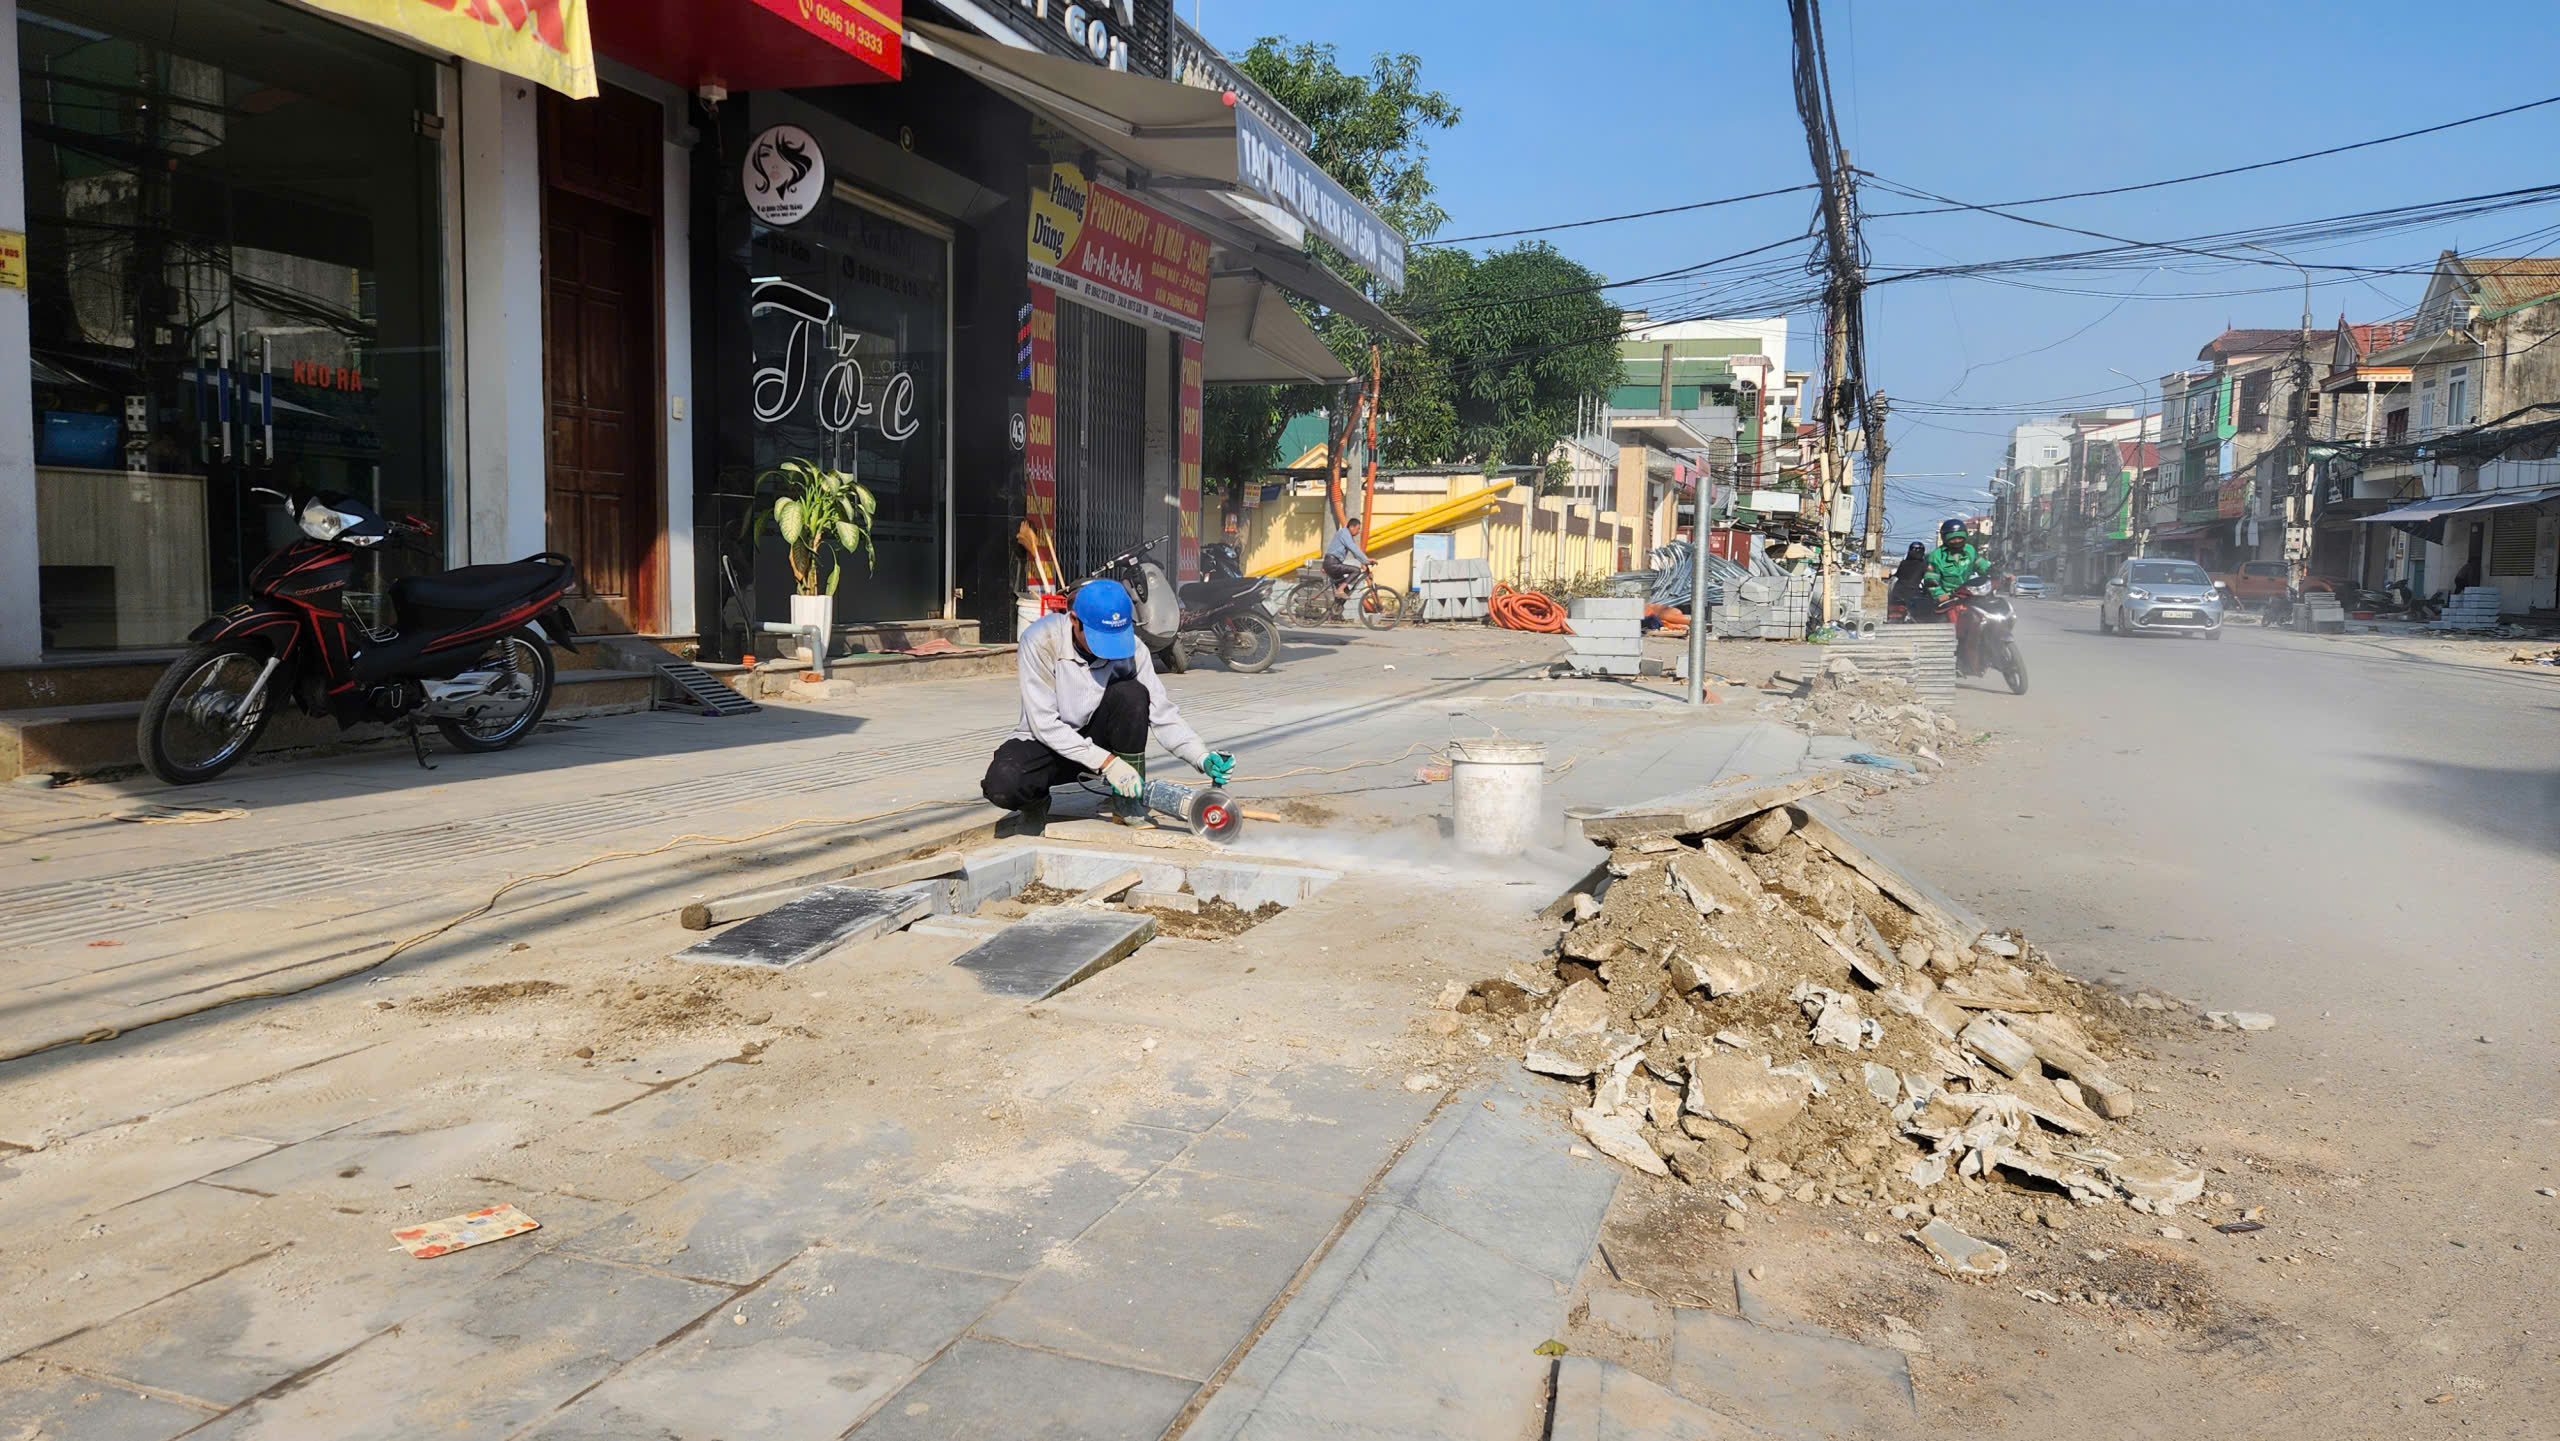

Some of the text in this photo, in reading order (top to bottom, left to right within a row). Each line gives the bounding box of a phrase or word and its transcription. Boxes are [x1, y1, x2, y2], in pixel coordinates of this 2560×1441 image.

[816, 3, 884, 55] 0946 14 3333
[1298, 170, 1320, 223] TÓC
[1320, 190, 1342, 240] KEN
[1089, 190, 1150, 249] PHOTOCOPY
[1187, 239, 1209, 277] SCAN
[292, 355, 363, 393] KÉO RA
[1012, 419, 1025, 444] 43
[1029, 412, 1052, 447] SCAN
[1183, 405, 1200, 437] COPY
